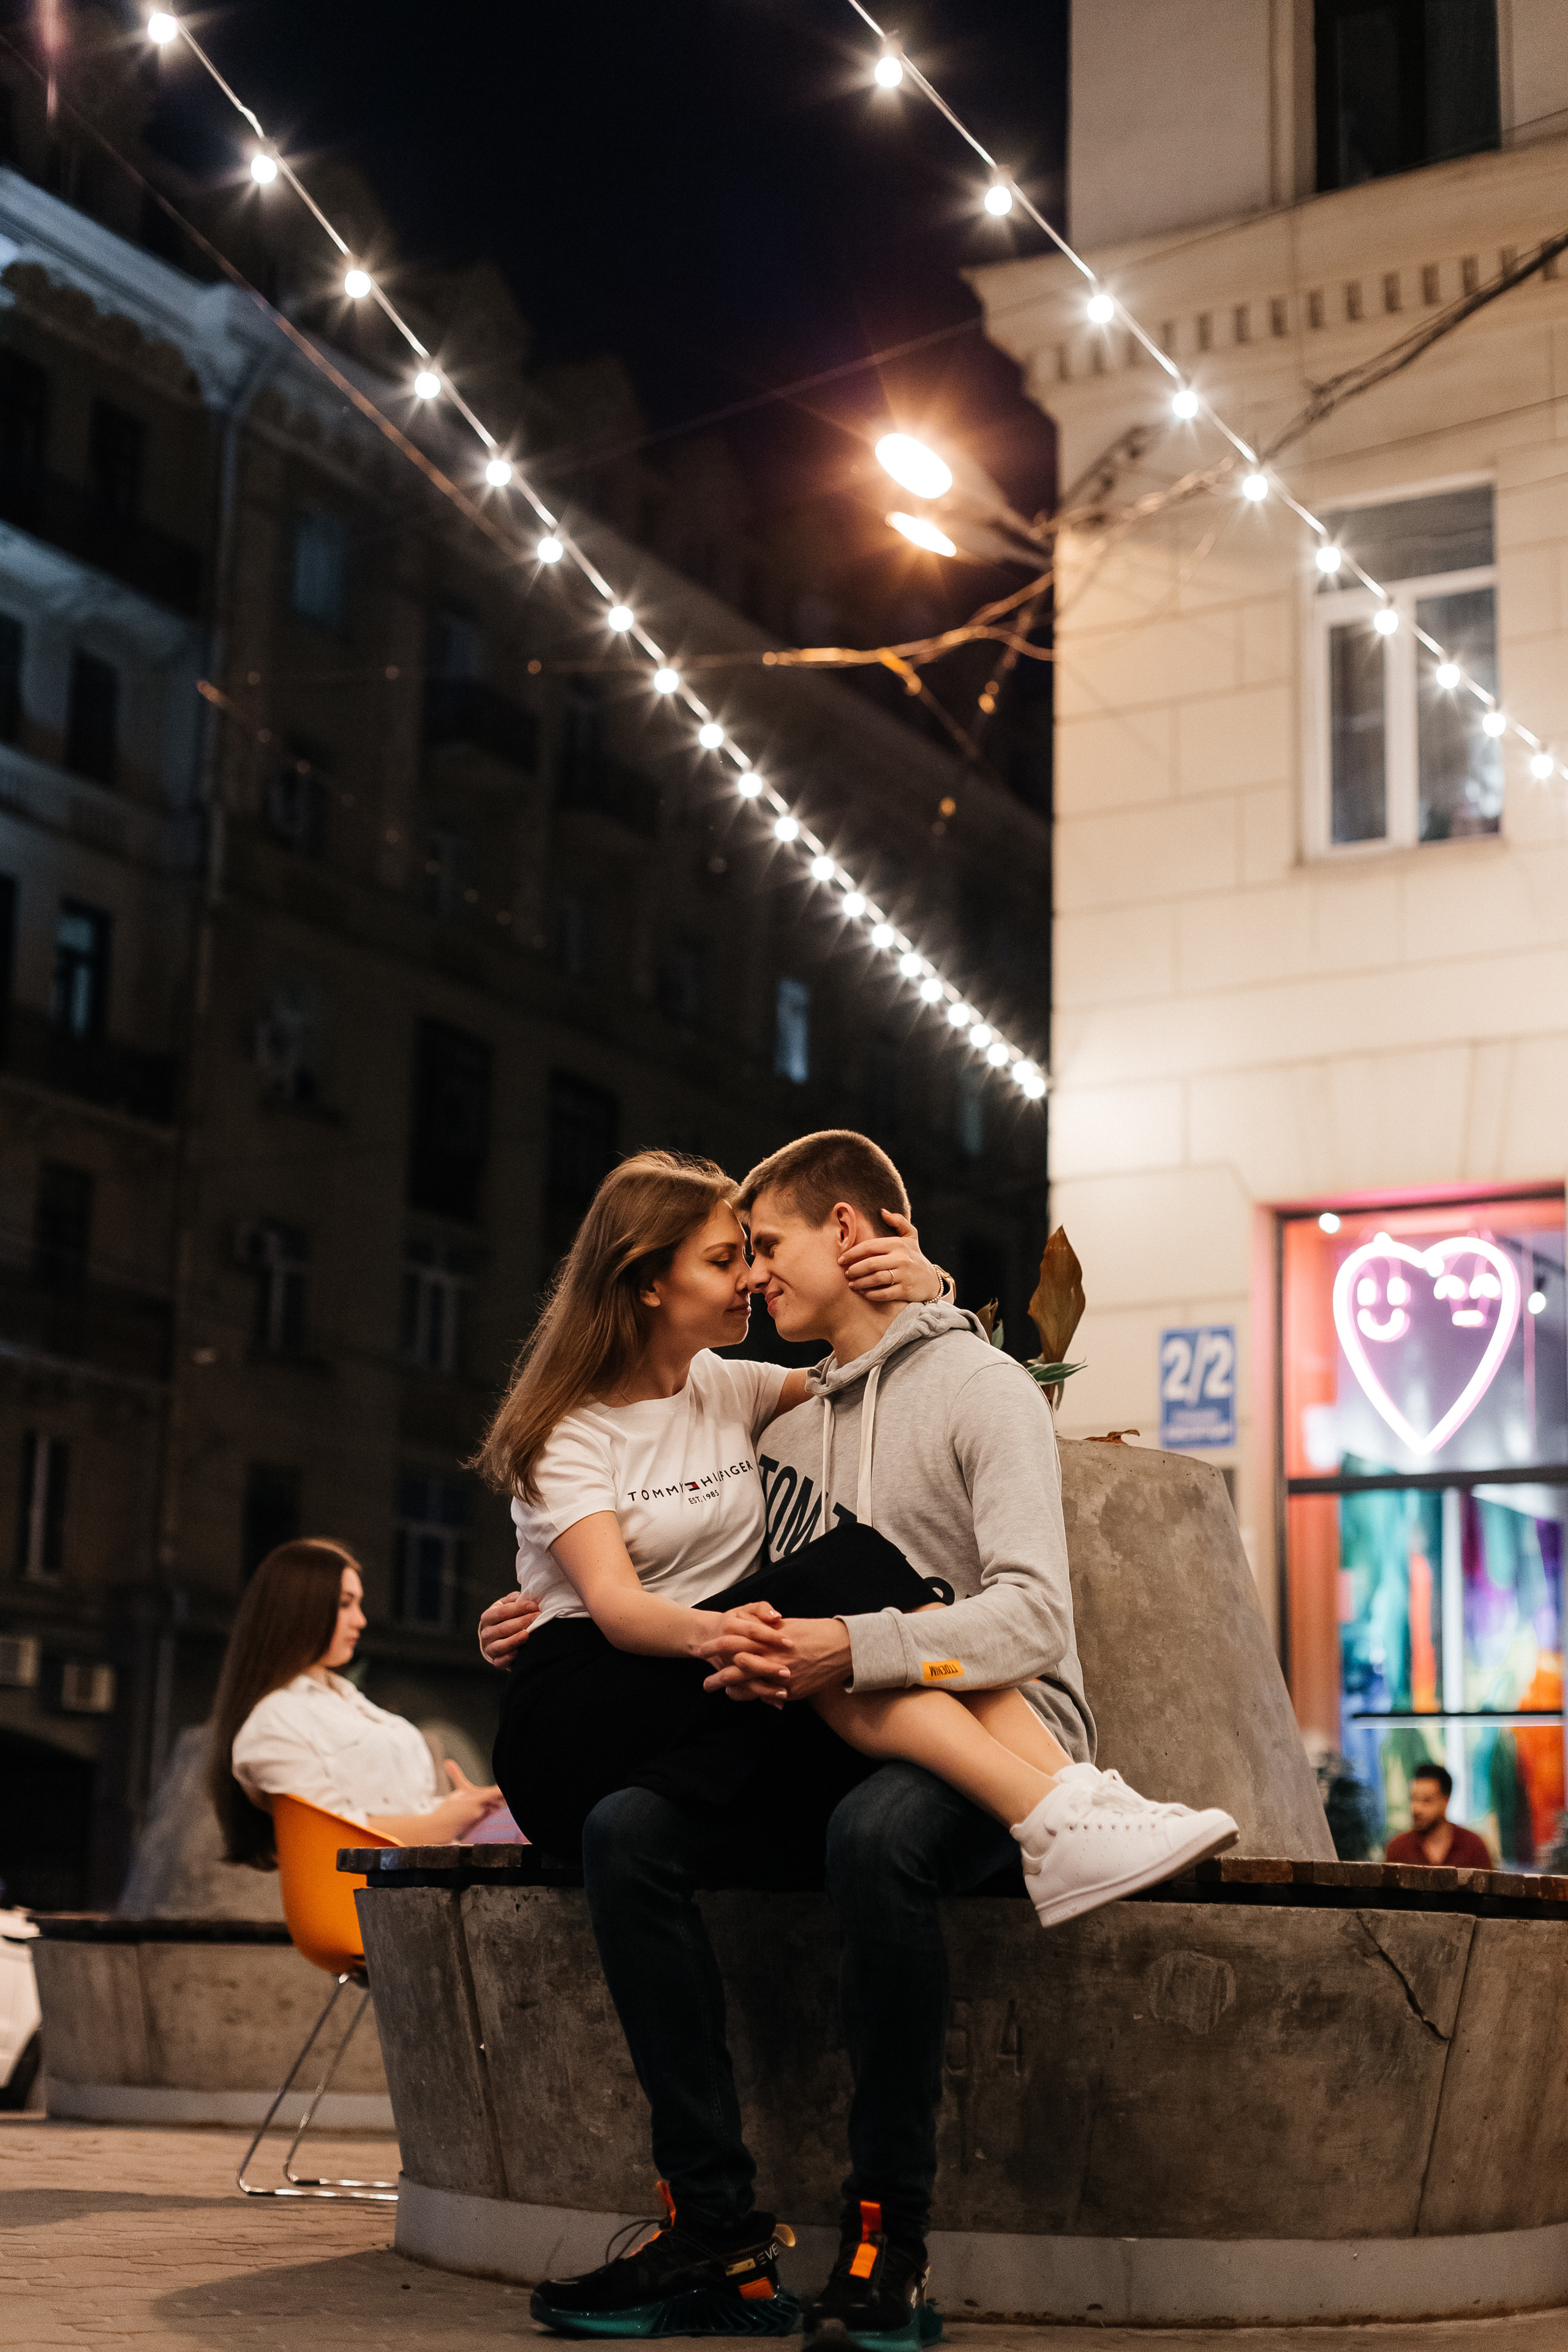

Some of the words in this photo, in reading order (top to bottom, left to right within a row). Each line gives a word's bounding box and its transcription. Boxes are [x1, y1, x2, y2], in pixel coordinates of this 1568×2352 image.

[1163, 1334, 1234, 1404] 2/2
[627, 1482, 684, 1501] TOMMY
[700, 1460, 753, 1487] HILFIGER
